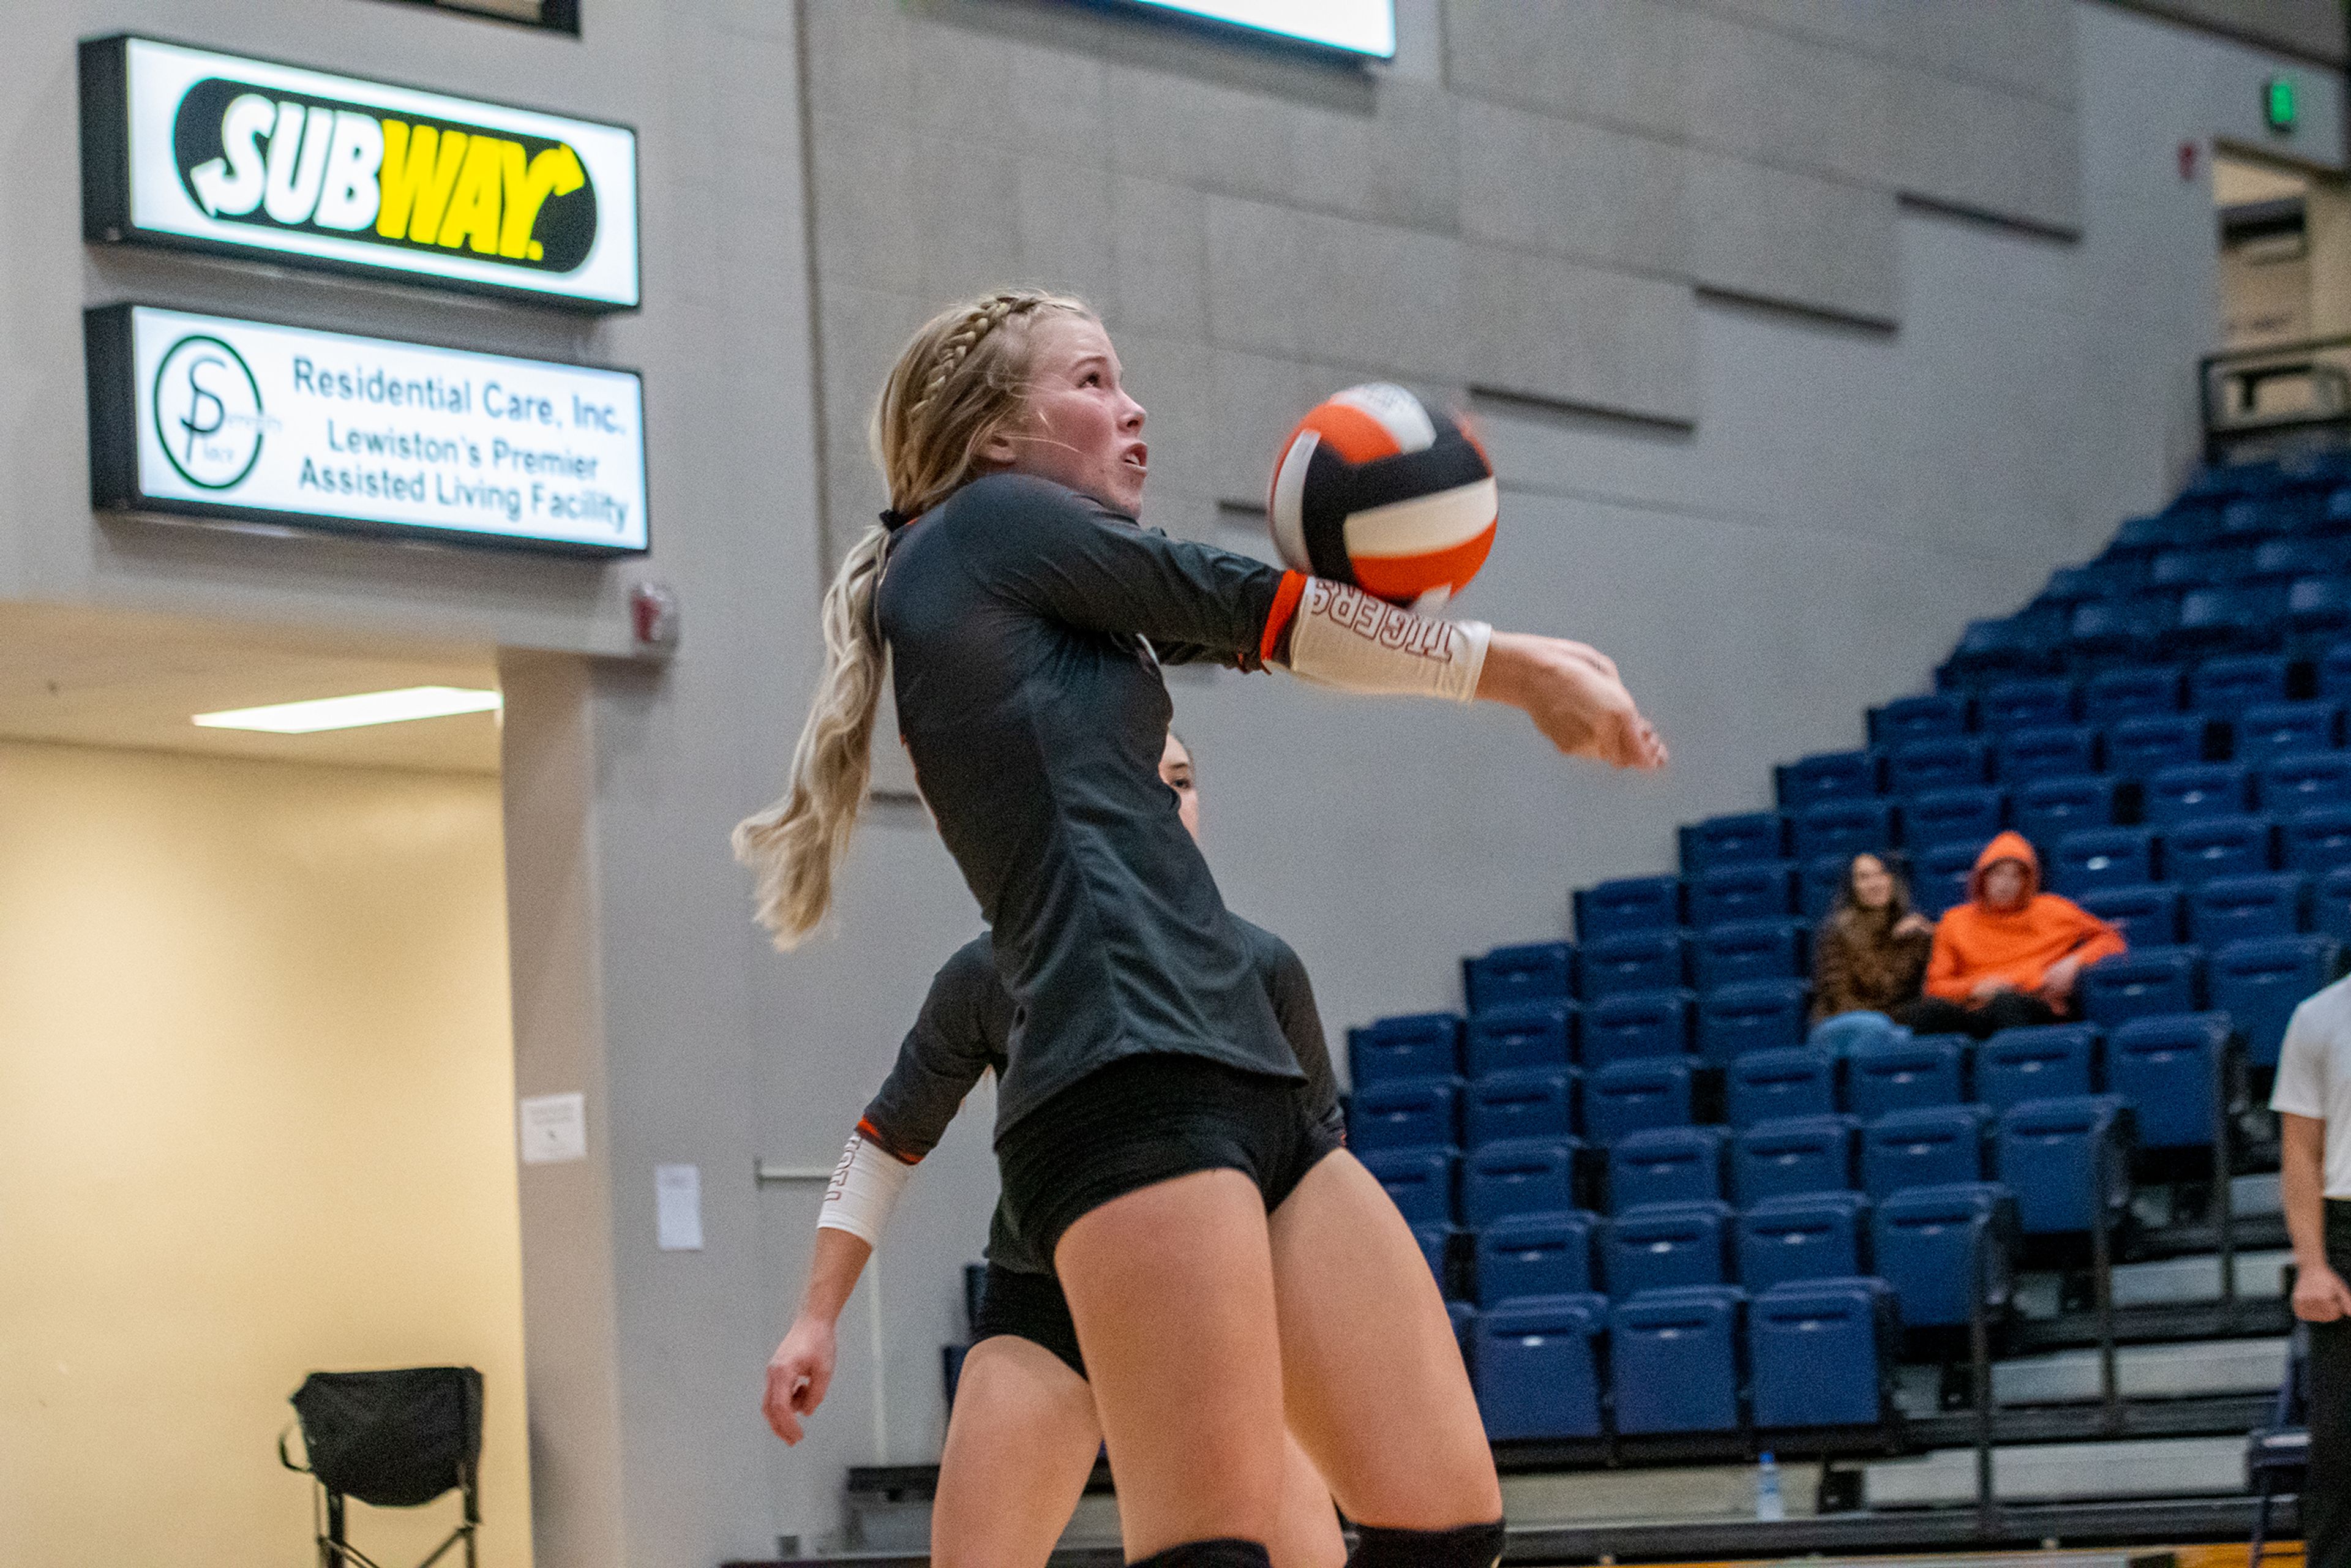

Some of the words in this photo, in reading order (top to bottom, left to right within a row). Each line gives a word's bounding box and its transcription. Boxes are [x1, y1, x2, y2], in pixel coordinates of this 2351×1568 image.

[294, 356, 471, 413] Residential
[572, 391, 626, 435] Inc.
[328, 417, 482, 468] Lewiston's
[492, 437, 598, 480] Premier
[299, 456, 426, 501] Assisted
[436, 471, 522, 522] Living
[531, 482, 628, 533] Facility
[1312, 580, 1453, 663] TIGERS
